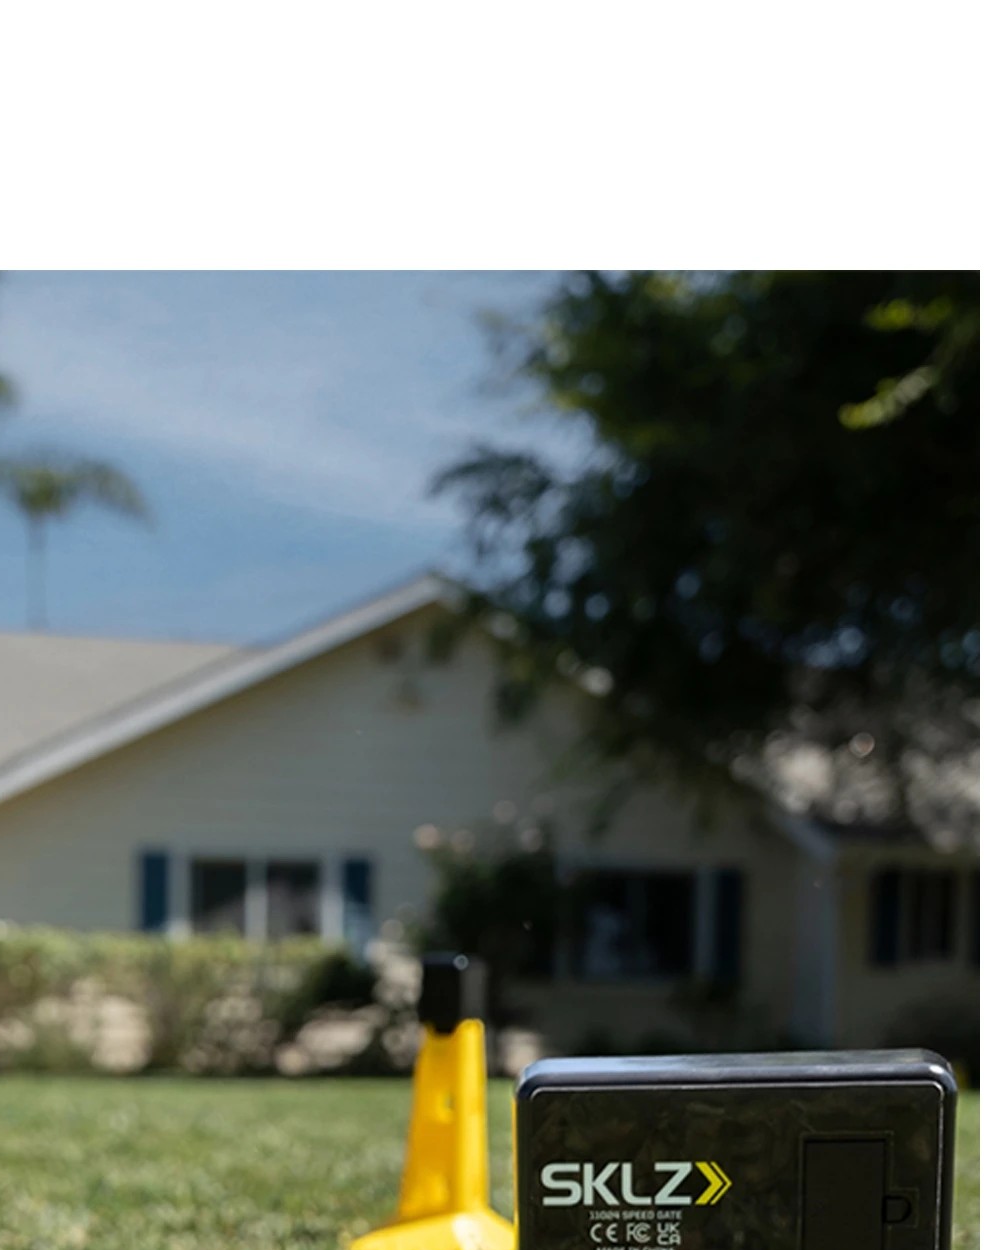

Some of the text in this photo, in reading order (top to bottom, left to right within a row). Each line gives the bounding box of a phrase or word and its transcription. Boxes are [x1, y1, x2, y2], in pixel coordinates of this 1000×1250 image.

[541, 1162, 693, 1206] SKLZ
[622, 1210, 655, 1220] SPEED
[656, 1210, 682, 1220] GATE
[590, 1223, 618, 1243] CE
